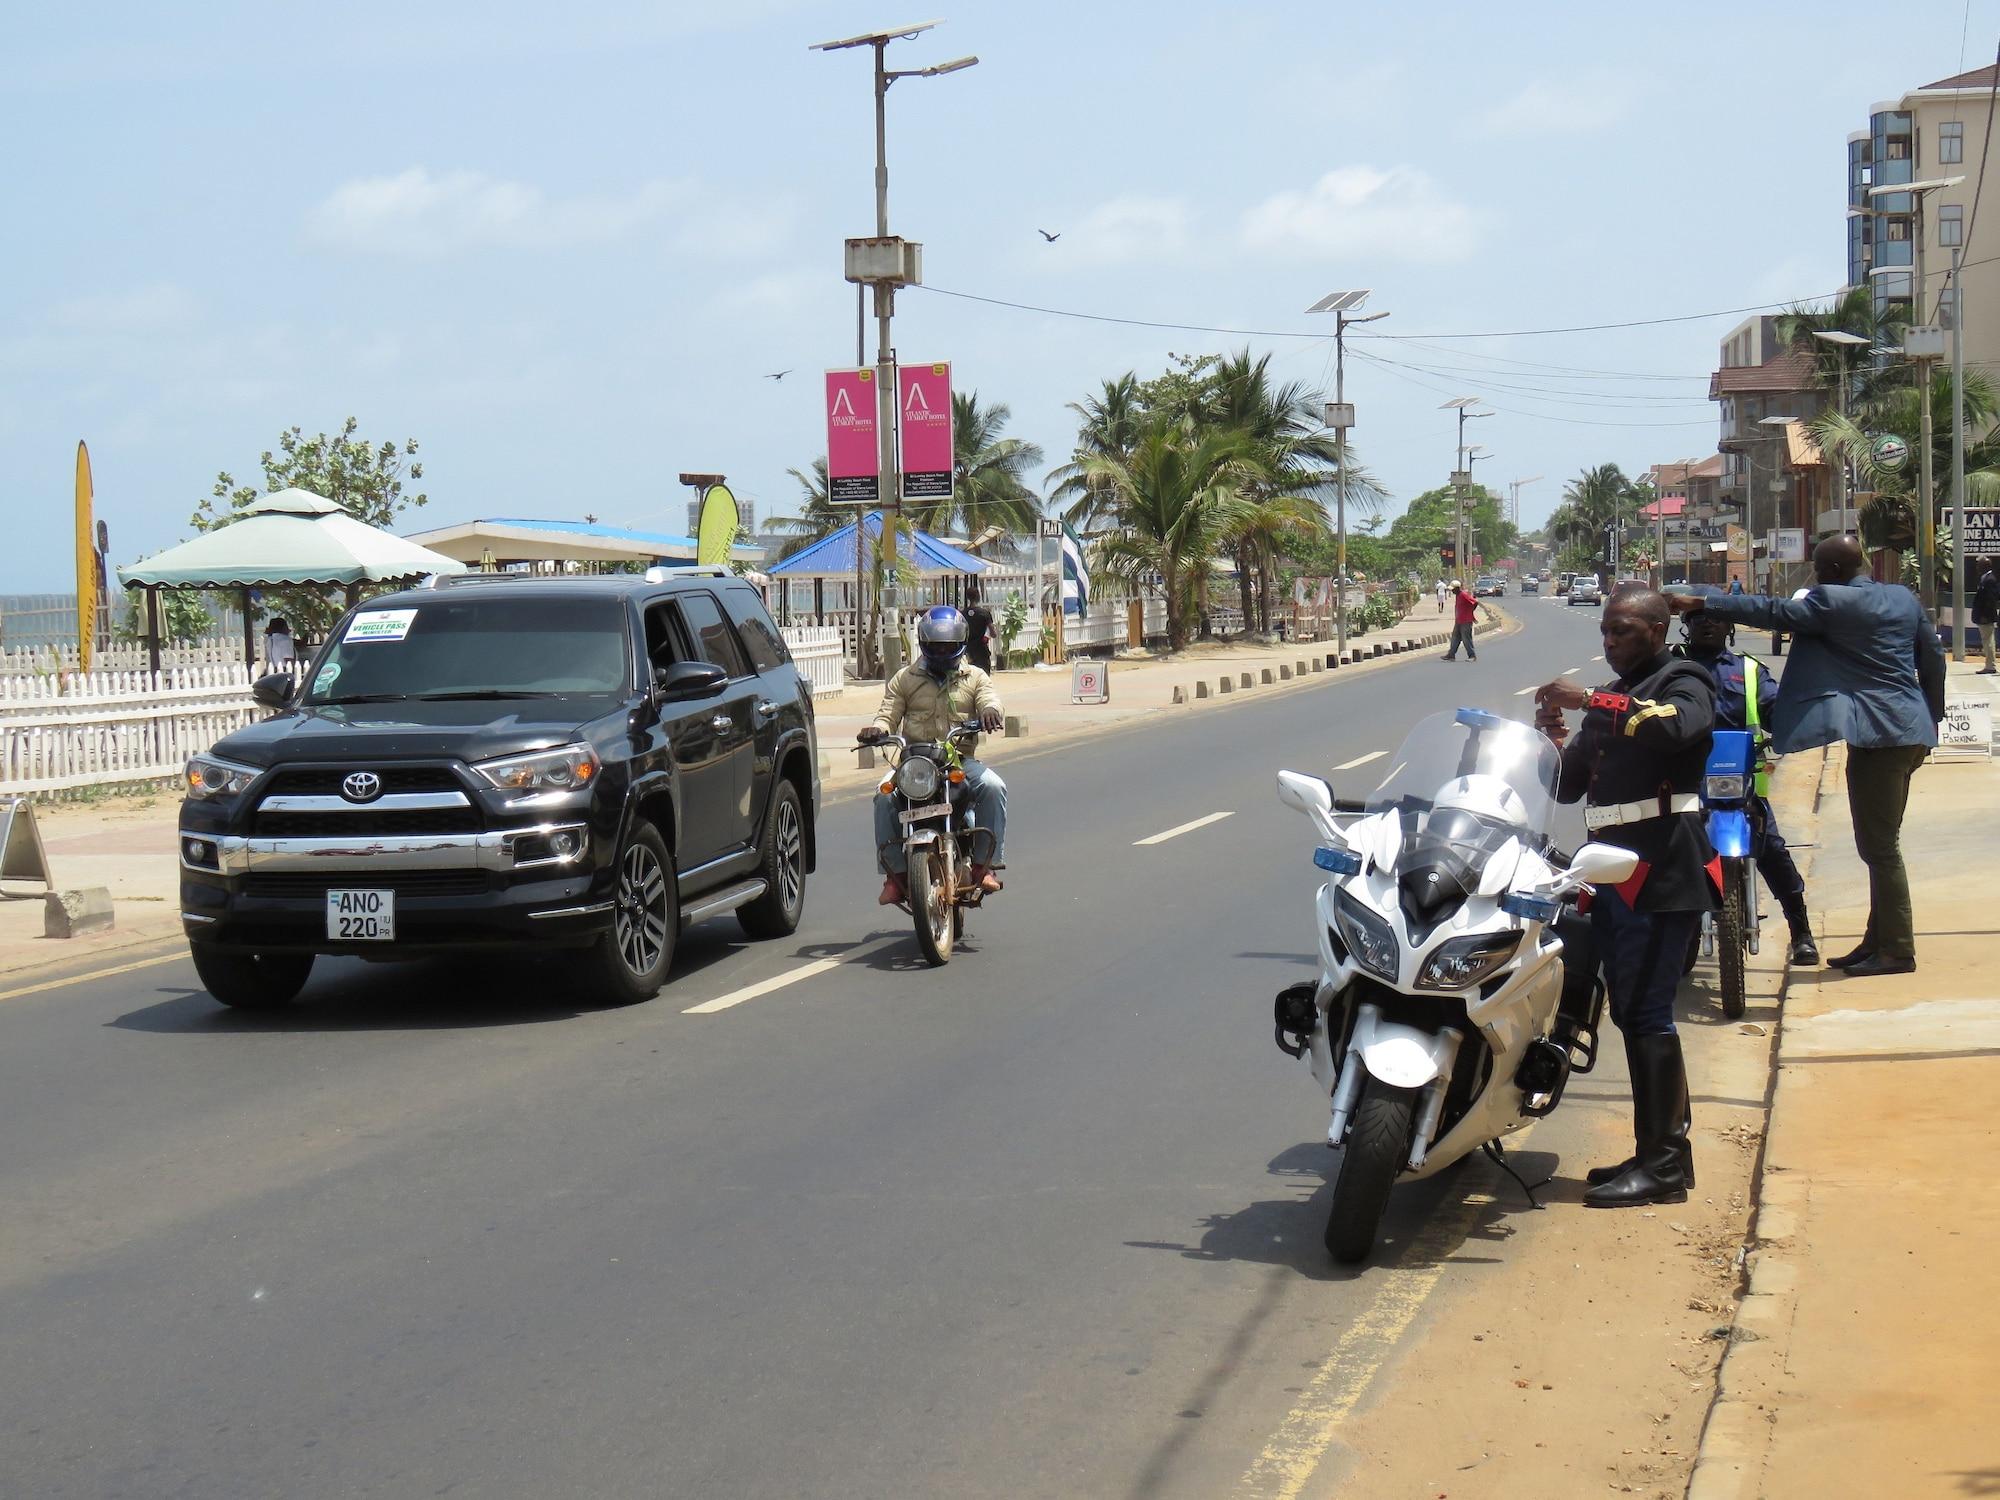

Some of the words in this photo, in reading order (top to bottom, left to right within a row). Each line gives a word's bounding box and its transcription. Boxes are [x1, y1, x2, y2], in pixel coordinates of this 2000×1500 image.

[1984, 529, 2000, 539] BA
[353, 623, 383, 632] VEHICLE
[385, 622, 407, 630] PASS
[1948, 721, 1970, 732] NO
[339, 892, 380, 913] ANO
[339, 917, 378, 938] 220
